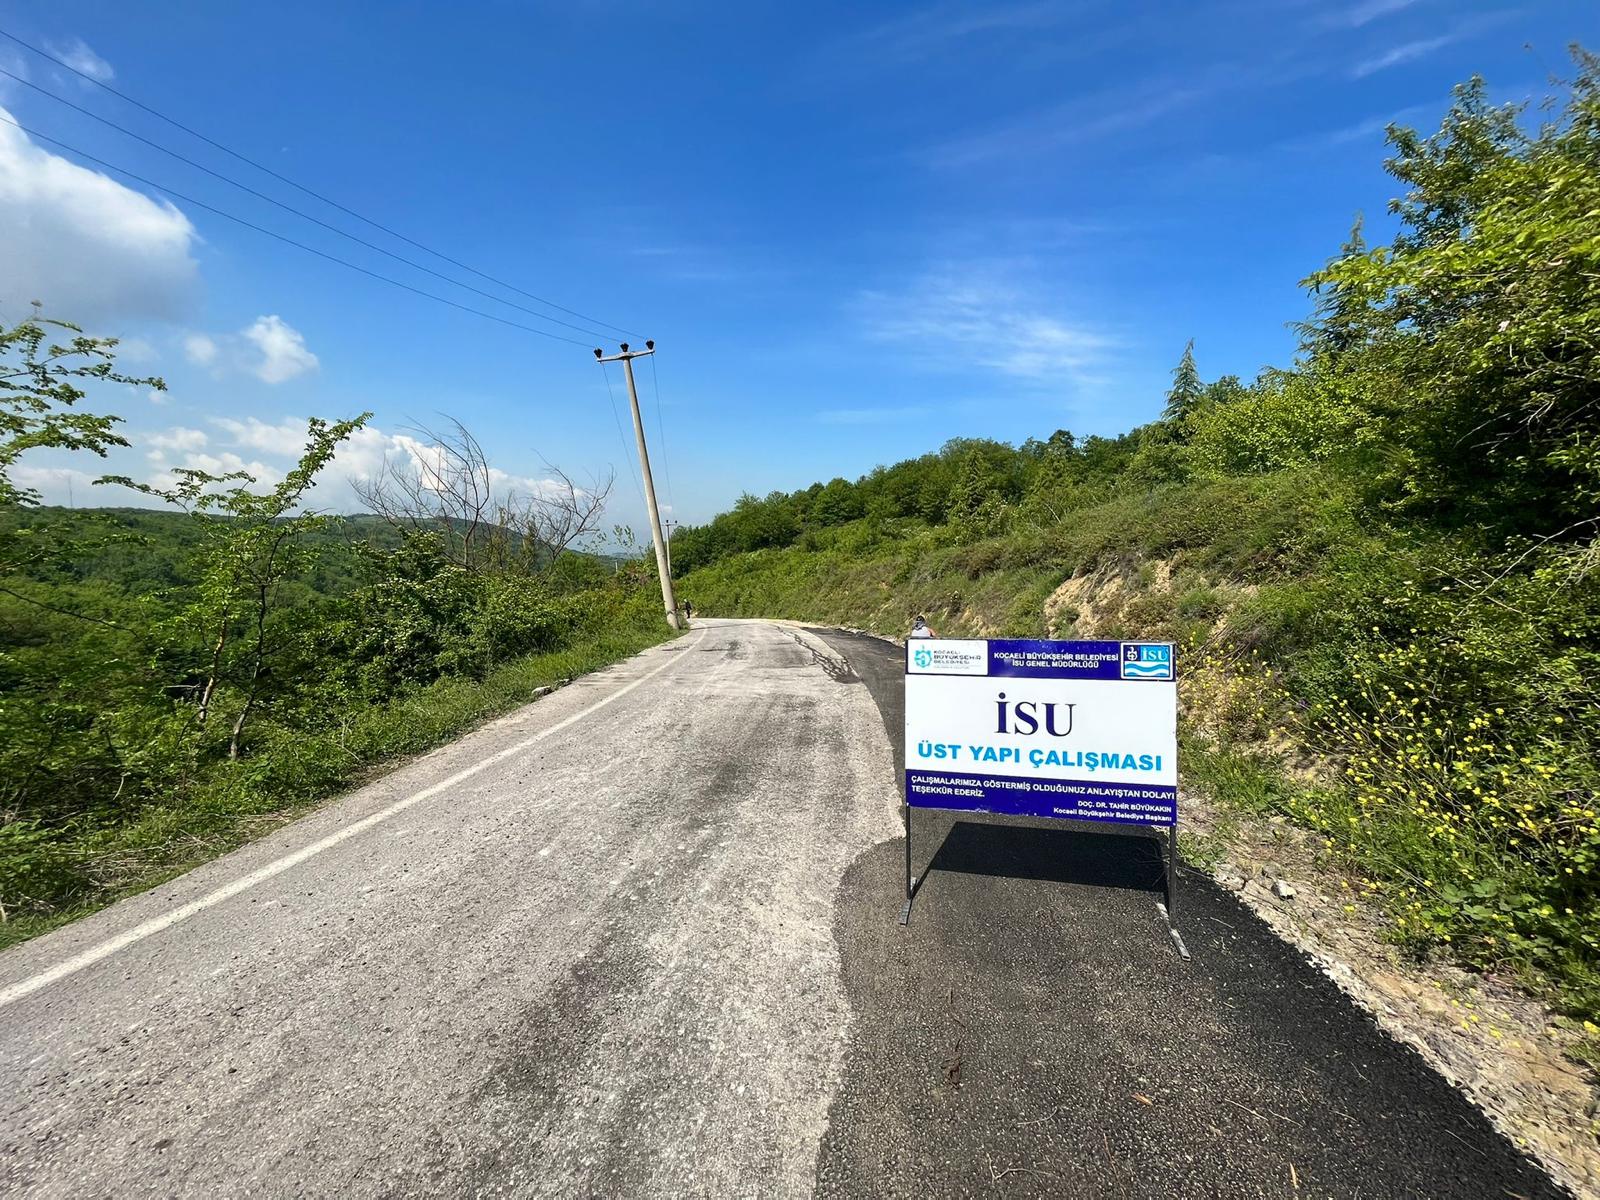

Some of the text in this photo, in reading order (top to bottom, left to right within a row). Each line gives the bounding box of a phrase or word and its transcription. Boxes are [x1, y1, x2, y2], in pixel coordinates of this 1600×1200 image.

[1027, 652, 1073, 660] BÜYÜKŞEHİR
[1075, 653, 1118, 661] BELEDİYESİ
[1141, 647, 1168, 662] İSU
[1052, 660, 1098, 668] MÜDÜRLÜĞÜ
[994, 692, 1077, 737] İSU
[918, 739, 1162, 772] ÜST YAPI ÇALIŞMASI
[911, 776, 1175, 800] ÇALIŞMALARIMIZA GÖSTERMİŞ OLDUĞUNUZ ANLAYIŞTAN DOLAYI
[912, 785, 985, 797] TEŞEKKÜR EDERİZ.
[1109, 802, 1130, 810] TAHİR
[1130, 804, 1172, 813] BÜYÜKAKIN
[1078, 810, 1114, 818] Büyükşehir
[1116, 812, 1144, 820] Belediye
[1145, 814, 1172, 822] Başkanı
